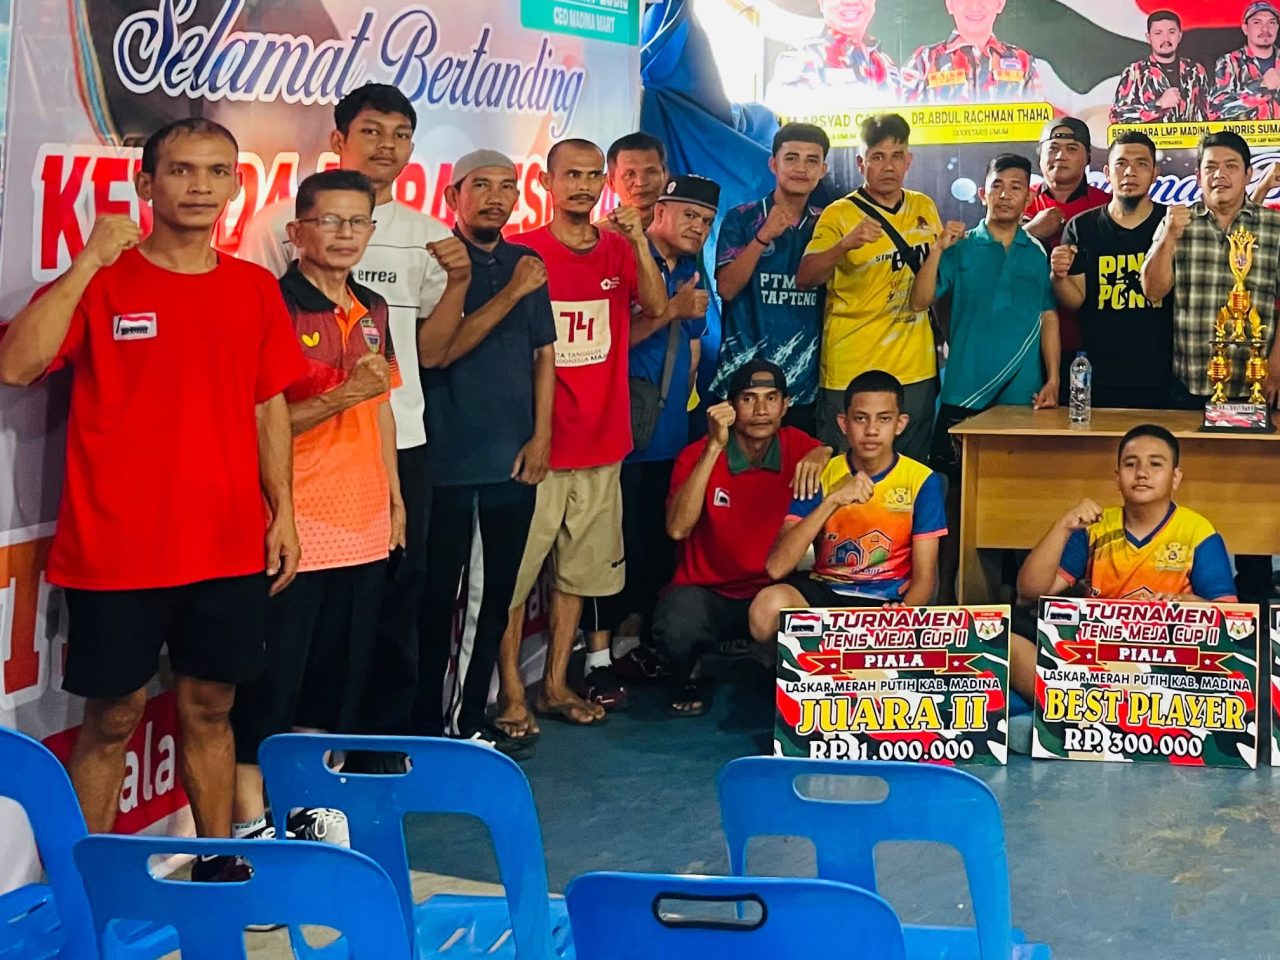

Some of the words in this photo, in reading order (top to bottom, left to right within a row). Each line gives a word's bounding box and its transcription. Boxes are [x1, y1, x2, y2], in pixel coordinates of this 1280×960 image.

[554, 6, 568, 26] CEO
[380, 6, 588, 134] Bertanding
[963, 109, 1015, 124] RACHMAN
[1017, 107, 1050, 122] THAHA
[1161, 126, 1177, 137] LMP
[1180, 125, 1210, 136] MADINA
[1098, 252, 1147, 285] PIN
[560, 311, 595, 343] 74
[829, 612, 964, 630] TURNAMEN
[1086, 603, 1215, 625] TURNAMEN
[824, 632, 868, 648] TENIS
[872, 632, 915, 648] MEJA
[920, 631, 951, 648] CUP
[954, 630, 968, 648] II
[1081, 623, 1122, 639] TENIS
[1128, 625, 1167, 641] MEJA
[1174, 627, 1205, 643] CUP
[1208, 628, 1220, 644] II
[864, 654, 924, 668] PIALA
[1119, 647, 1176, 662] PIALA
[786, 682, 831, 693] LASKAR
[835, 681, 876, 692] MERAH
[880, 680, 915, 691] PUTIH
[919, 679, 947, 690] KAB.
[950, 678, 1000, 690] MADINA
[1043, 670, 1087, 683] LASKAR
[1090, 672, 1129, 684] MERAH
[1134, 674, 1167, 686] PUTIH
[1172, 675, 1199, 688] KAB.
[1202, 677, 1250, 691] MADINA
[798, 696, 942, 733] JUARA
[953, 694, 988, 731] II
[1044, 689, 1122, 724] BEST
[1129, 692, 1246, 731] PLAYER
[809, 739, 849, 760] RP.
[858, 739, 974, 761] 1.000.000
[1064, 728, 1104, 752] RP.
[1110, 732, 1202, 756] 300.000
